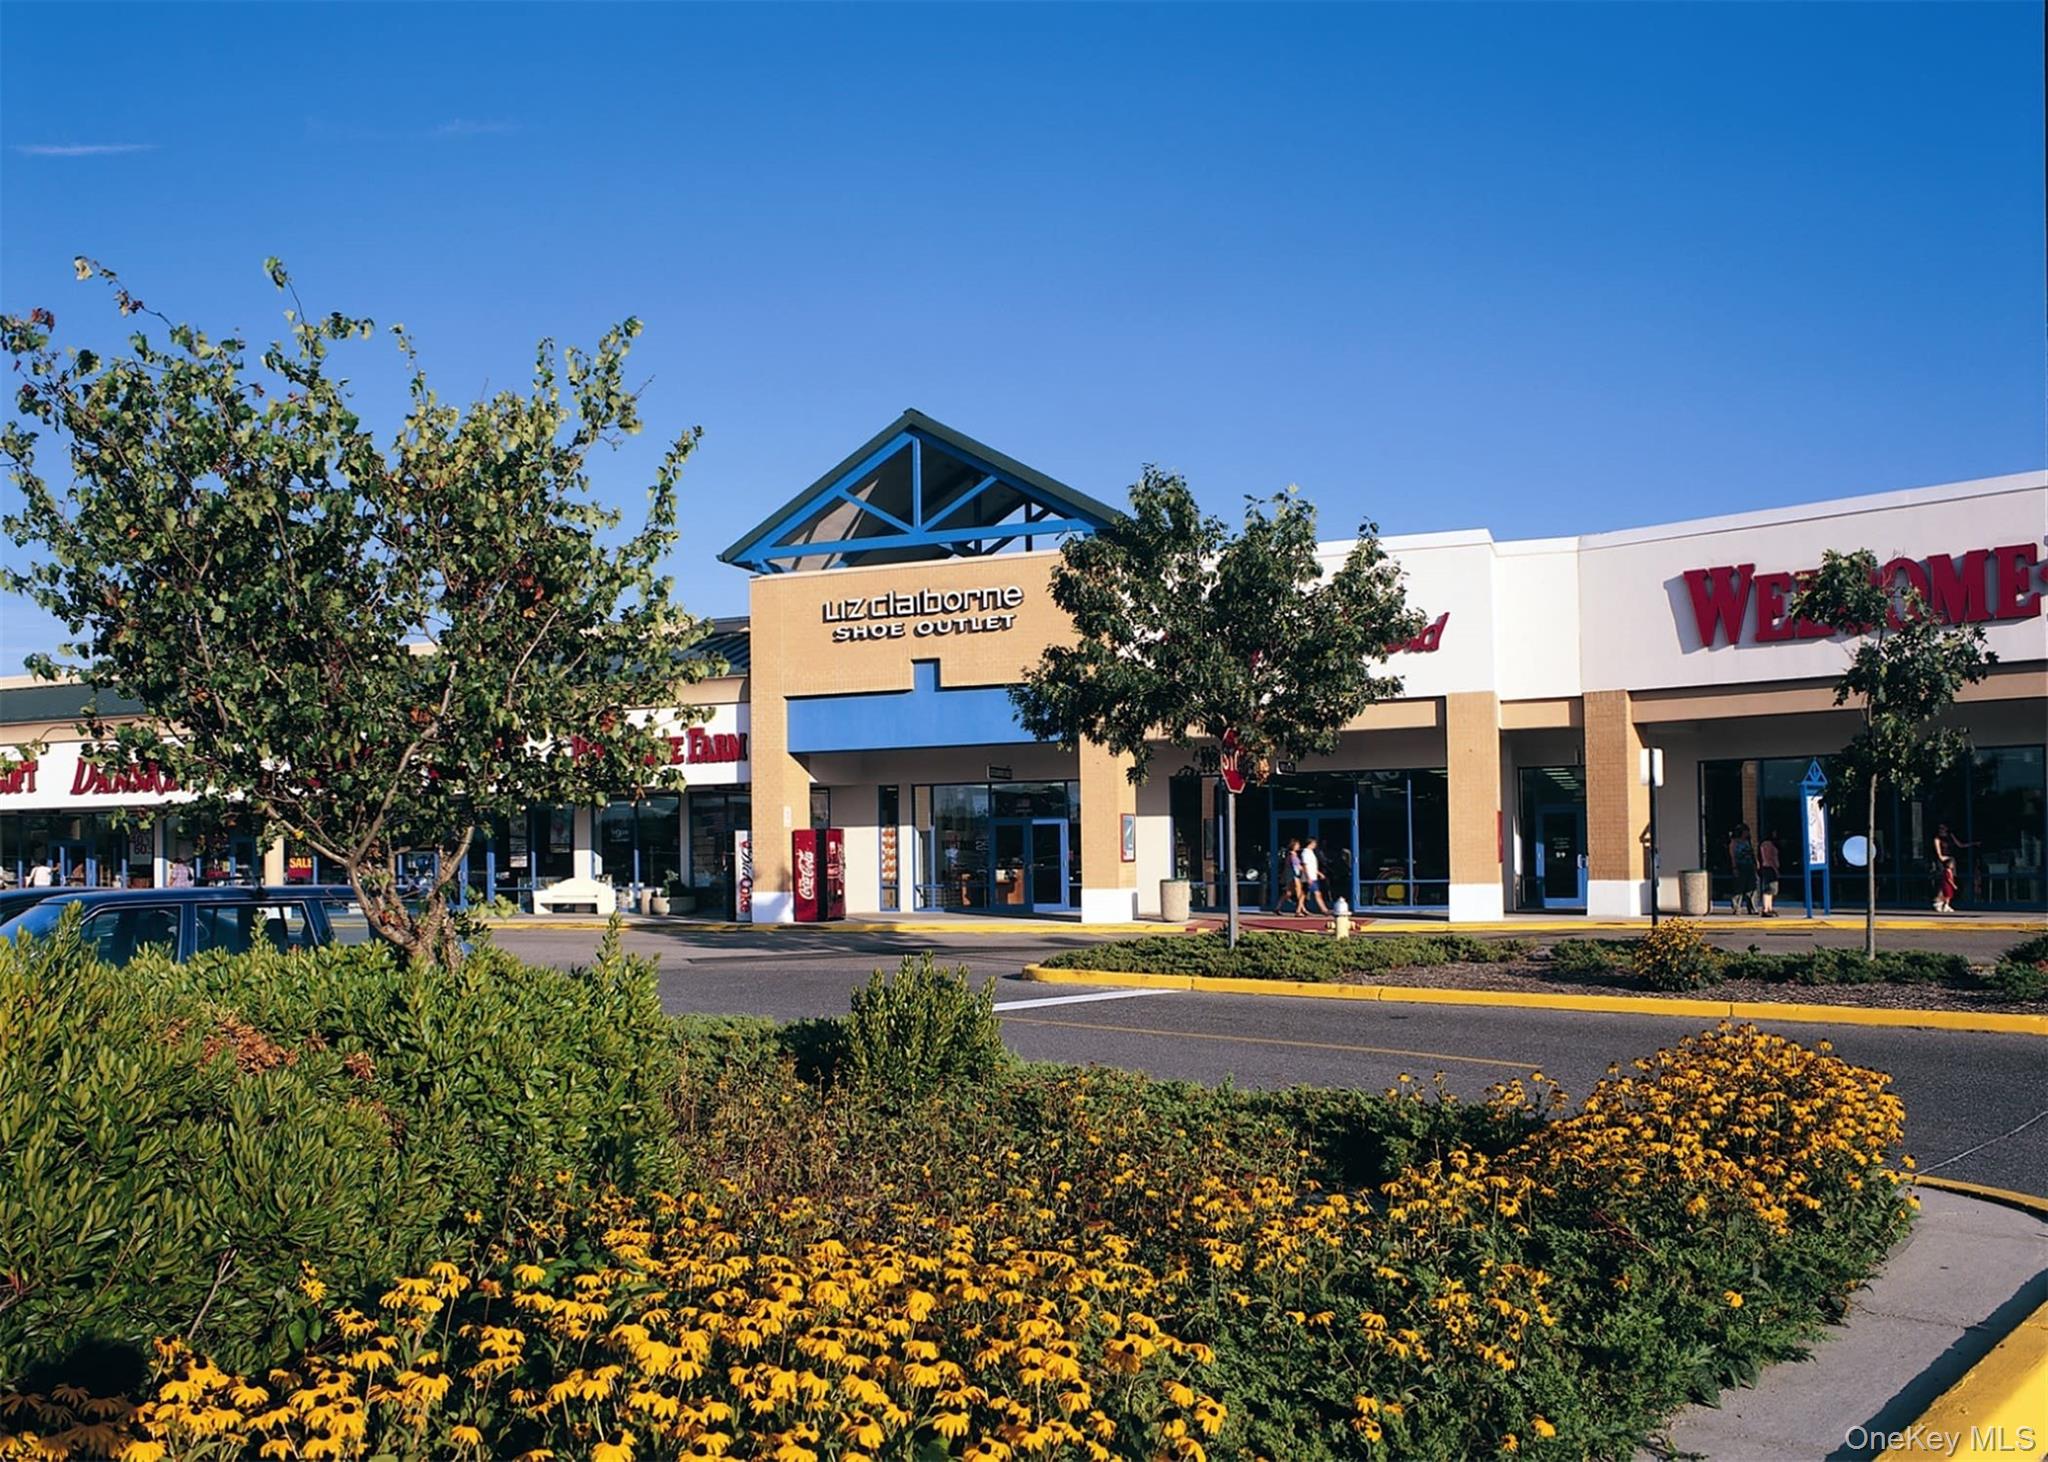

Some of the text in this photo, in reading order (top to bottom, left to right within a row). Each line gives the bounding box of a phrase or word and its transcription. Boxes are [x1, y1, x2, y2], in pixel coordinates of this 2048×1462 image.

[869, 585, 1024, 619] claiborne
[834, 614, 1016, 642] SHOE OUTLET
[688, 727, 747, 764] FARM
[289, 857, 312, 868] SALE
